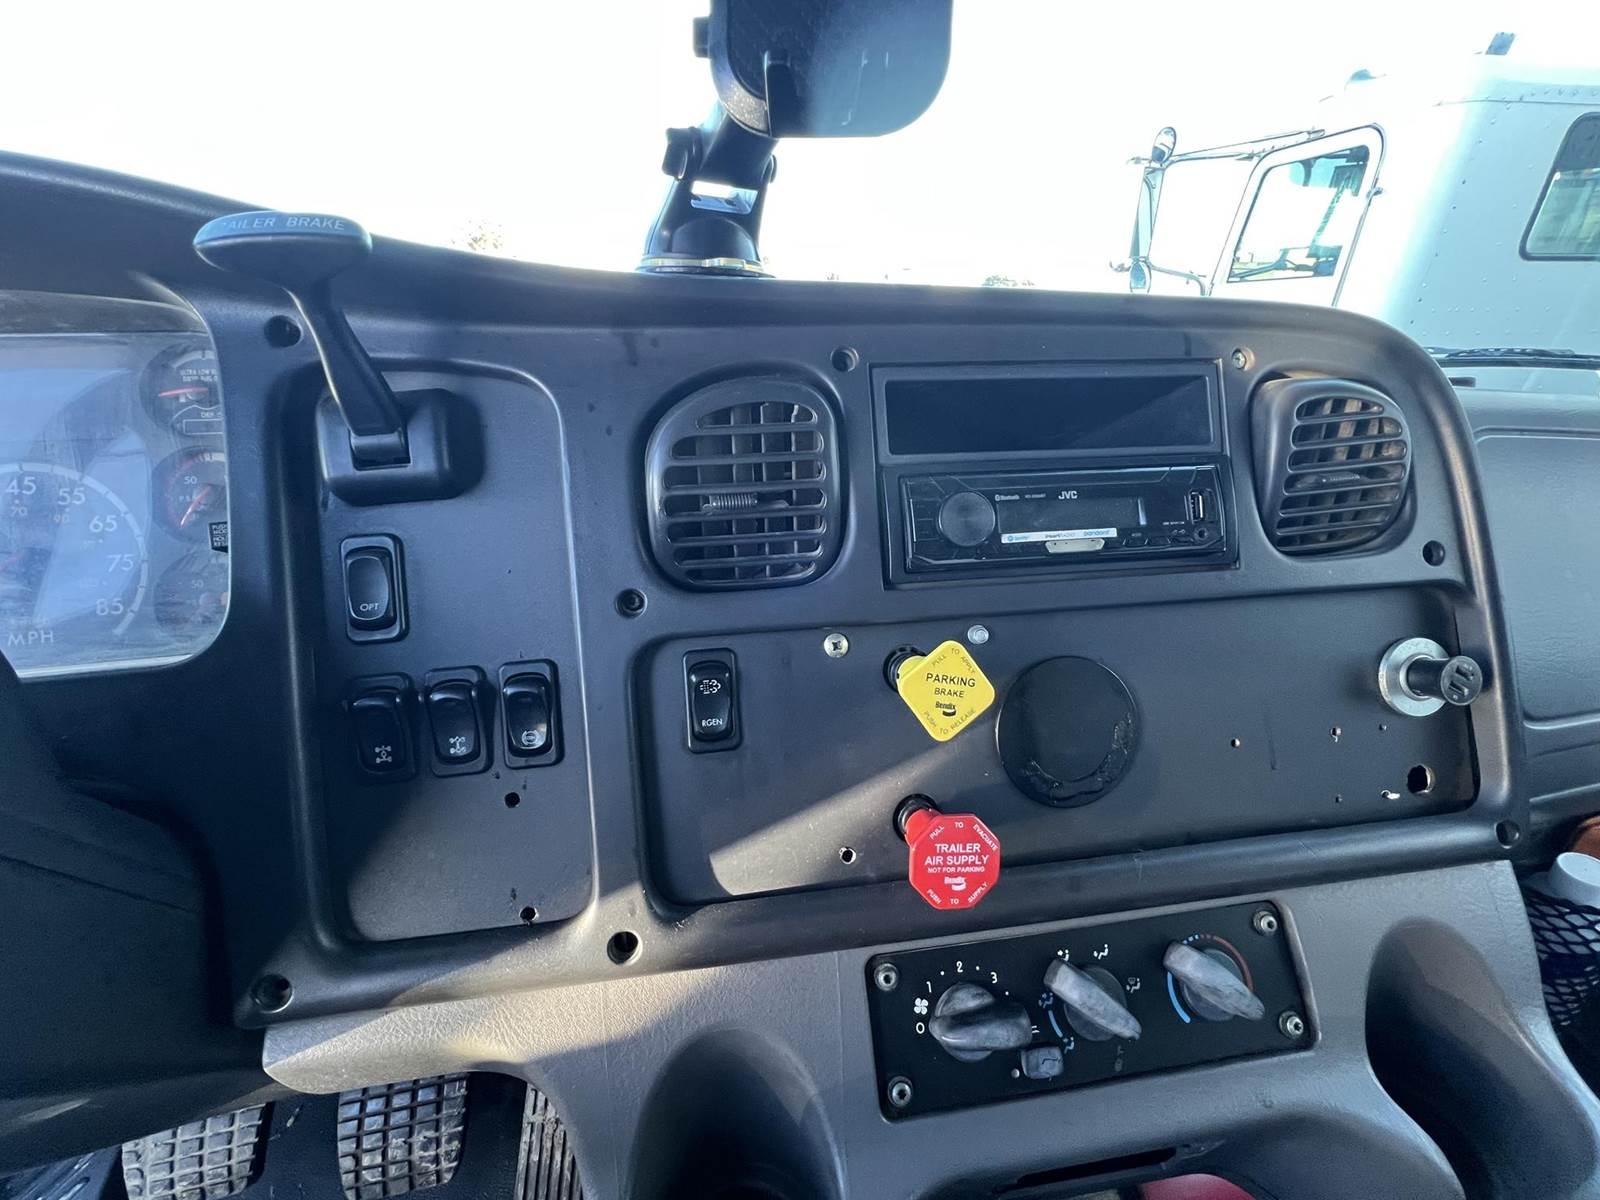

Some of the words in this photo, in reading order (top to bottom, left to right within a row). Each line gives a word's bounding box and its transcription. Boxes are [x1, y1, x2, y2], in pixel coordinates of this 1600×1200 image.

[286, 216, 346, 231] BRAKE
[5, 476, 37, 496] 45
[183, 475, 198, 485] 50
[57, 487, 86, 505] 55
[1058, 490, 1078, 500] JVC
[11, 506, 28, 517] 70
[89, 514, 117, 533] 65
[107, 553, 134, 573] 75
[95, 598, 124, 616] 85
[359, 602, 379, 612] OPT
[7, 630, 55, 647] MPH
[931, 654, 947, 667] PULL
[951, 647, 960, 655] TO
[961, 656, 976, 674] APPLY
[926, 672, 976, 688] PARKING
[934, 687, 965, 698] BRAKE
[701, 718, 723, 727] RGEN
[923, 711, 937, 728] PUSH
[940, 727, 949, 735] TO
[950, 707, 976, 730] RELEASE
[929, 825, 945, 840] PULL
[954, 821, 964, 829] TO
[973, 823, 998, 852] EVACUATE
[934, 843, 981, 853] TRAILER
[924, 856, 944, 866] AIR
[946, 854, 990, 866] SUPPLY
[926, 889, 942, 905] PUSH
[967, 882, 988, 903] SUPPLY
[956, 960, 963, 973] 2
[990, 971, 998, 984] 3
[926, 981, 932, 993] 1
